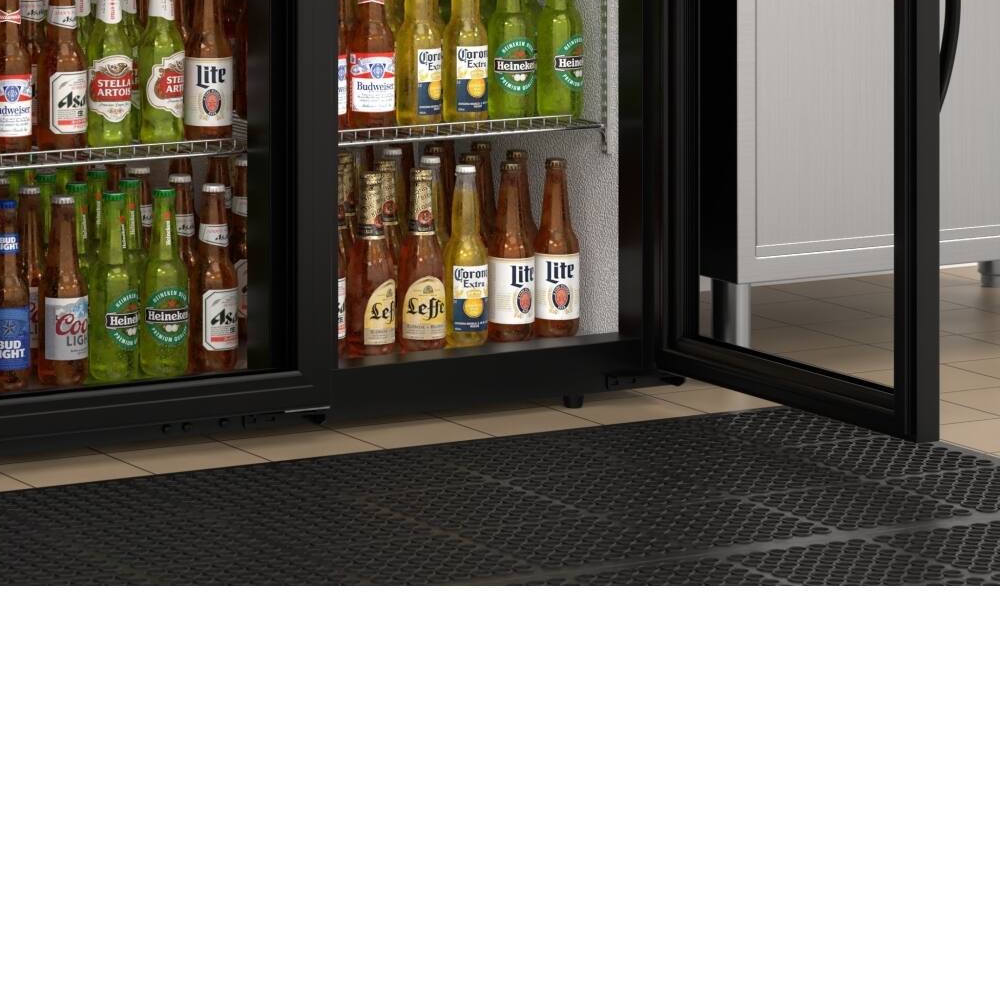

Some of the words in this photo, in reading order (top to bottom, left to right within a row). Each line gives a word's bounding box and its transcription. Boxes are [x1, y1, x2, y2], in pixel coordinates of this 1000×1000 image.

[196, 64, 227, 89] Lite
[0, 236, 17, 244] BUD
[545, 260, 575, 283] Lite
[407, 298, 446, 322] Leffe
